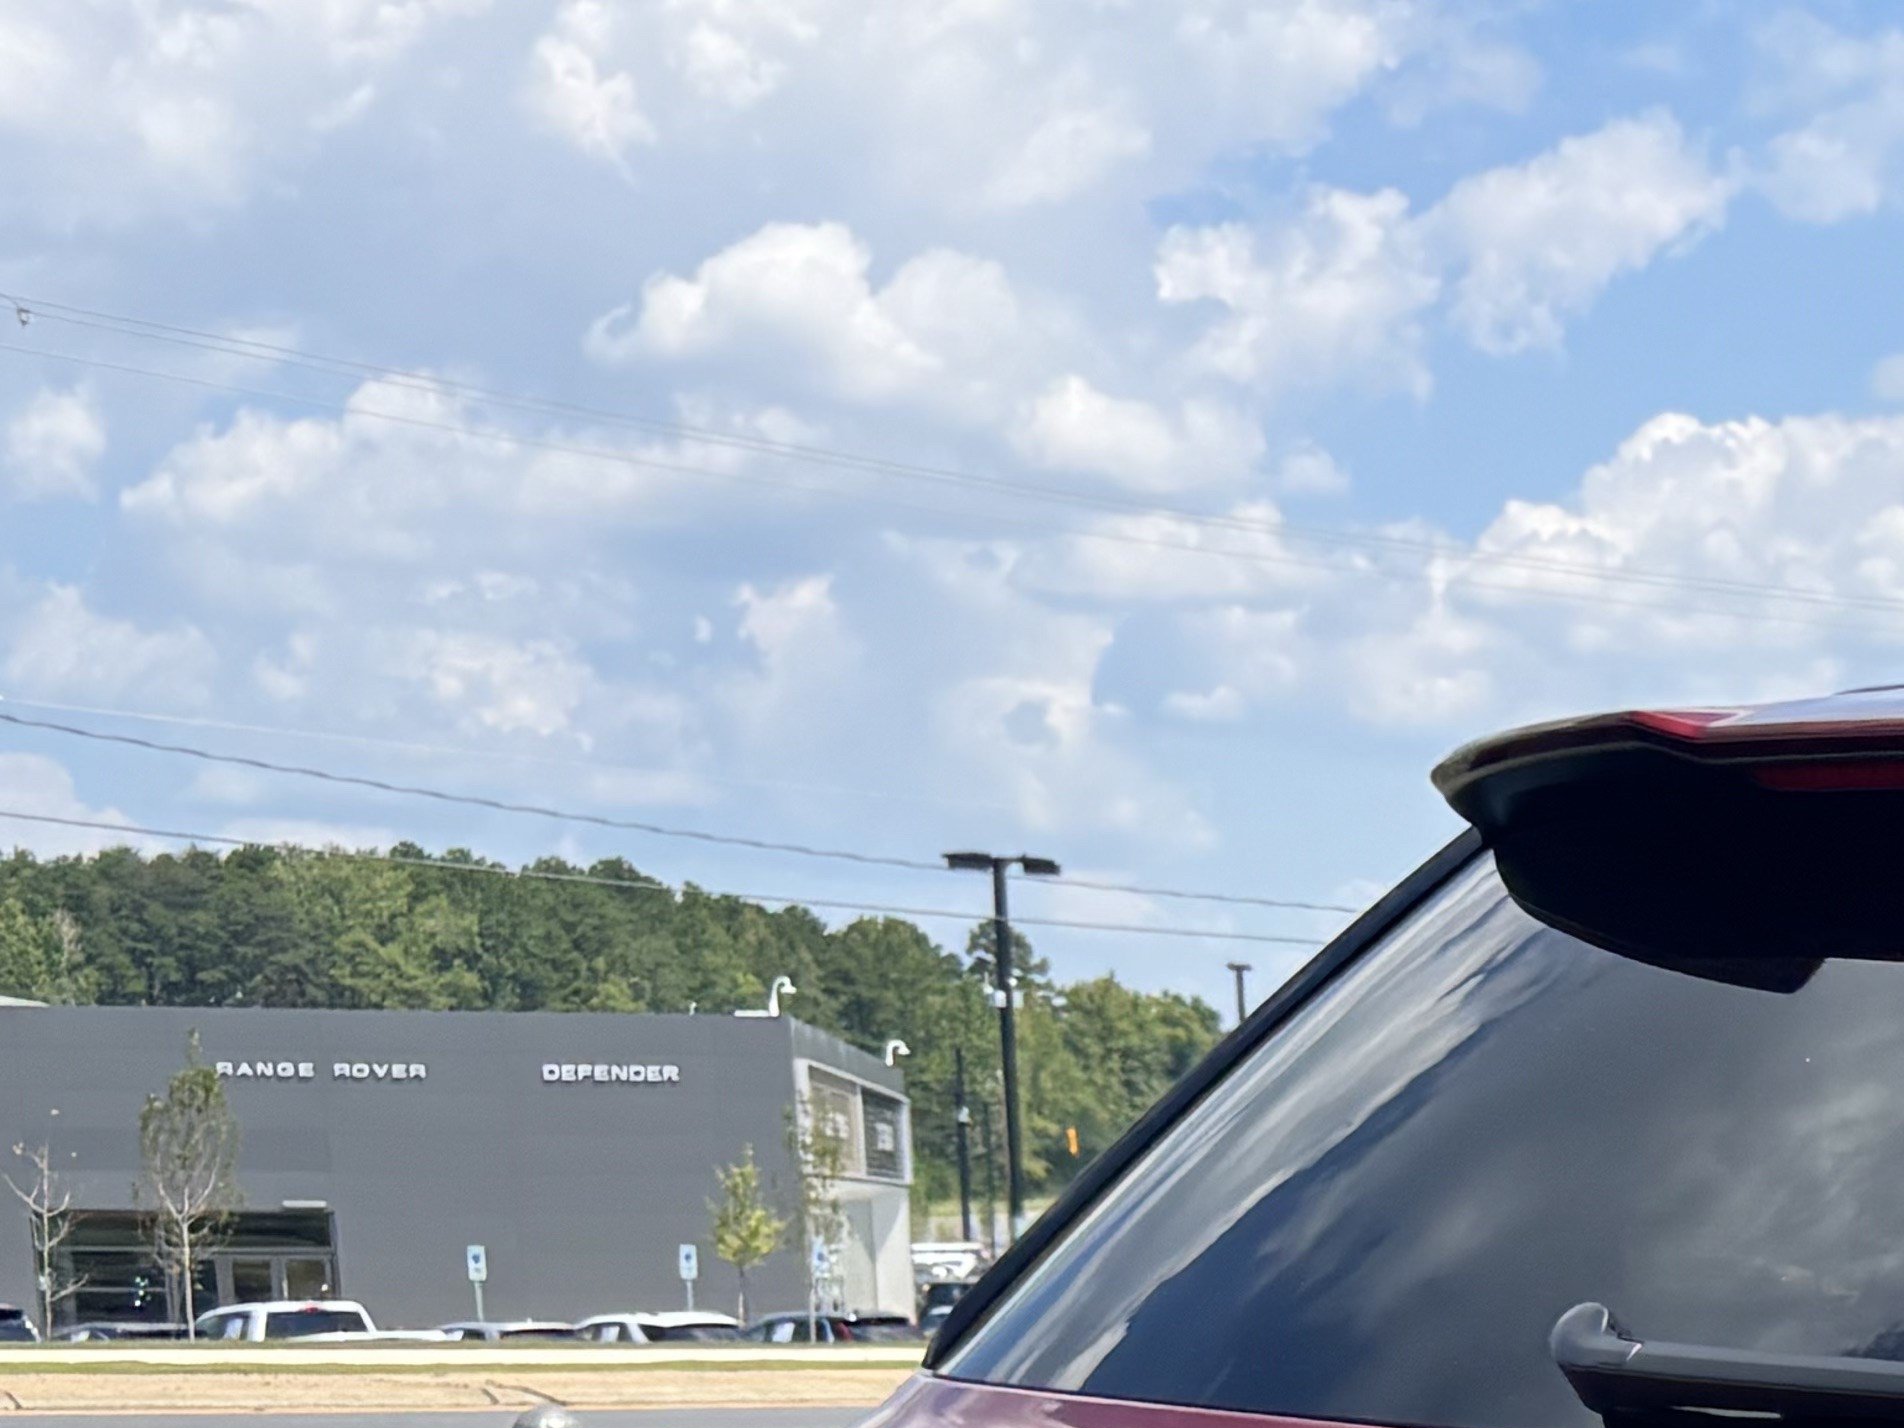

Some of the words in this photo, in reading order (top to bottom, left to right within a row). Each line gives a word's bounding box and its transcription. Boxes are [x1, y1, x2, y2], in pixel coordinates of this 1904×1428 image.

[216, 1061, 315, 1078] RANGE
[333, 1062, 427, 1079] ROVER
[542, 1063, 680, 1082] DEFENDER
